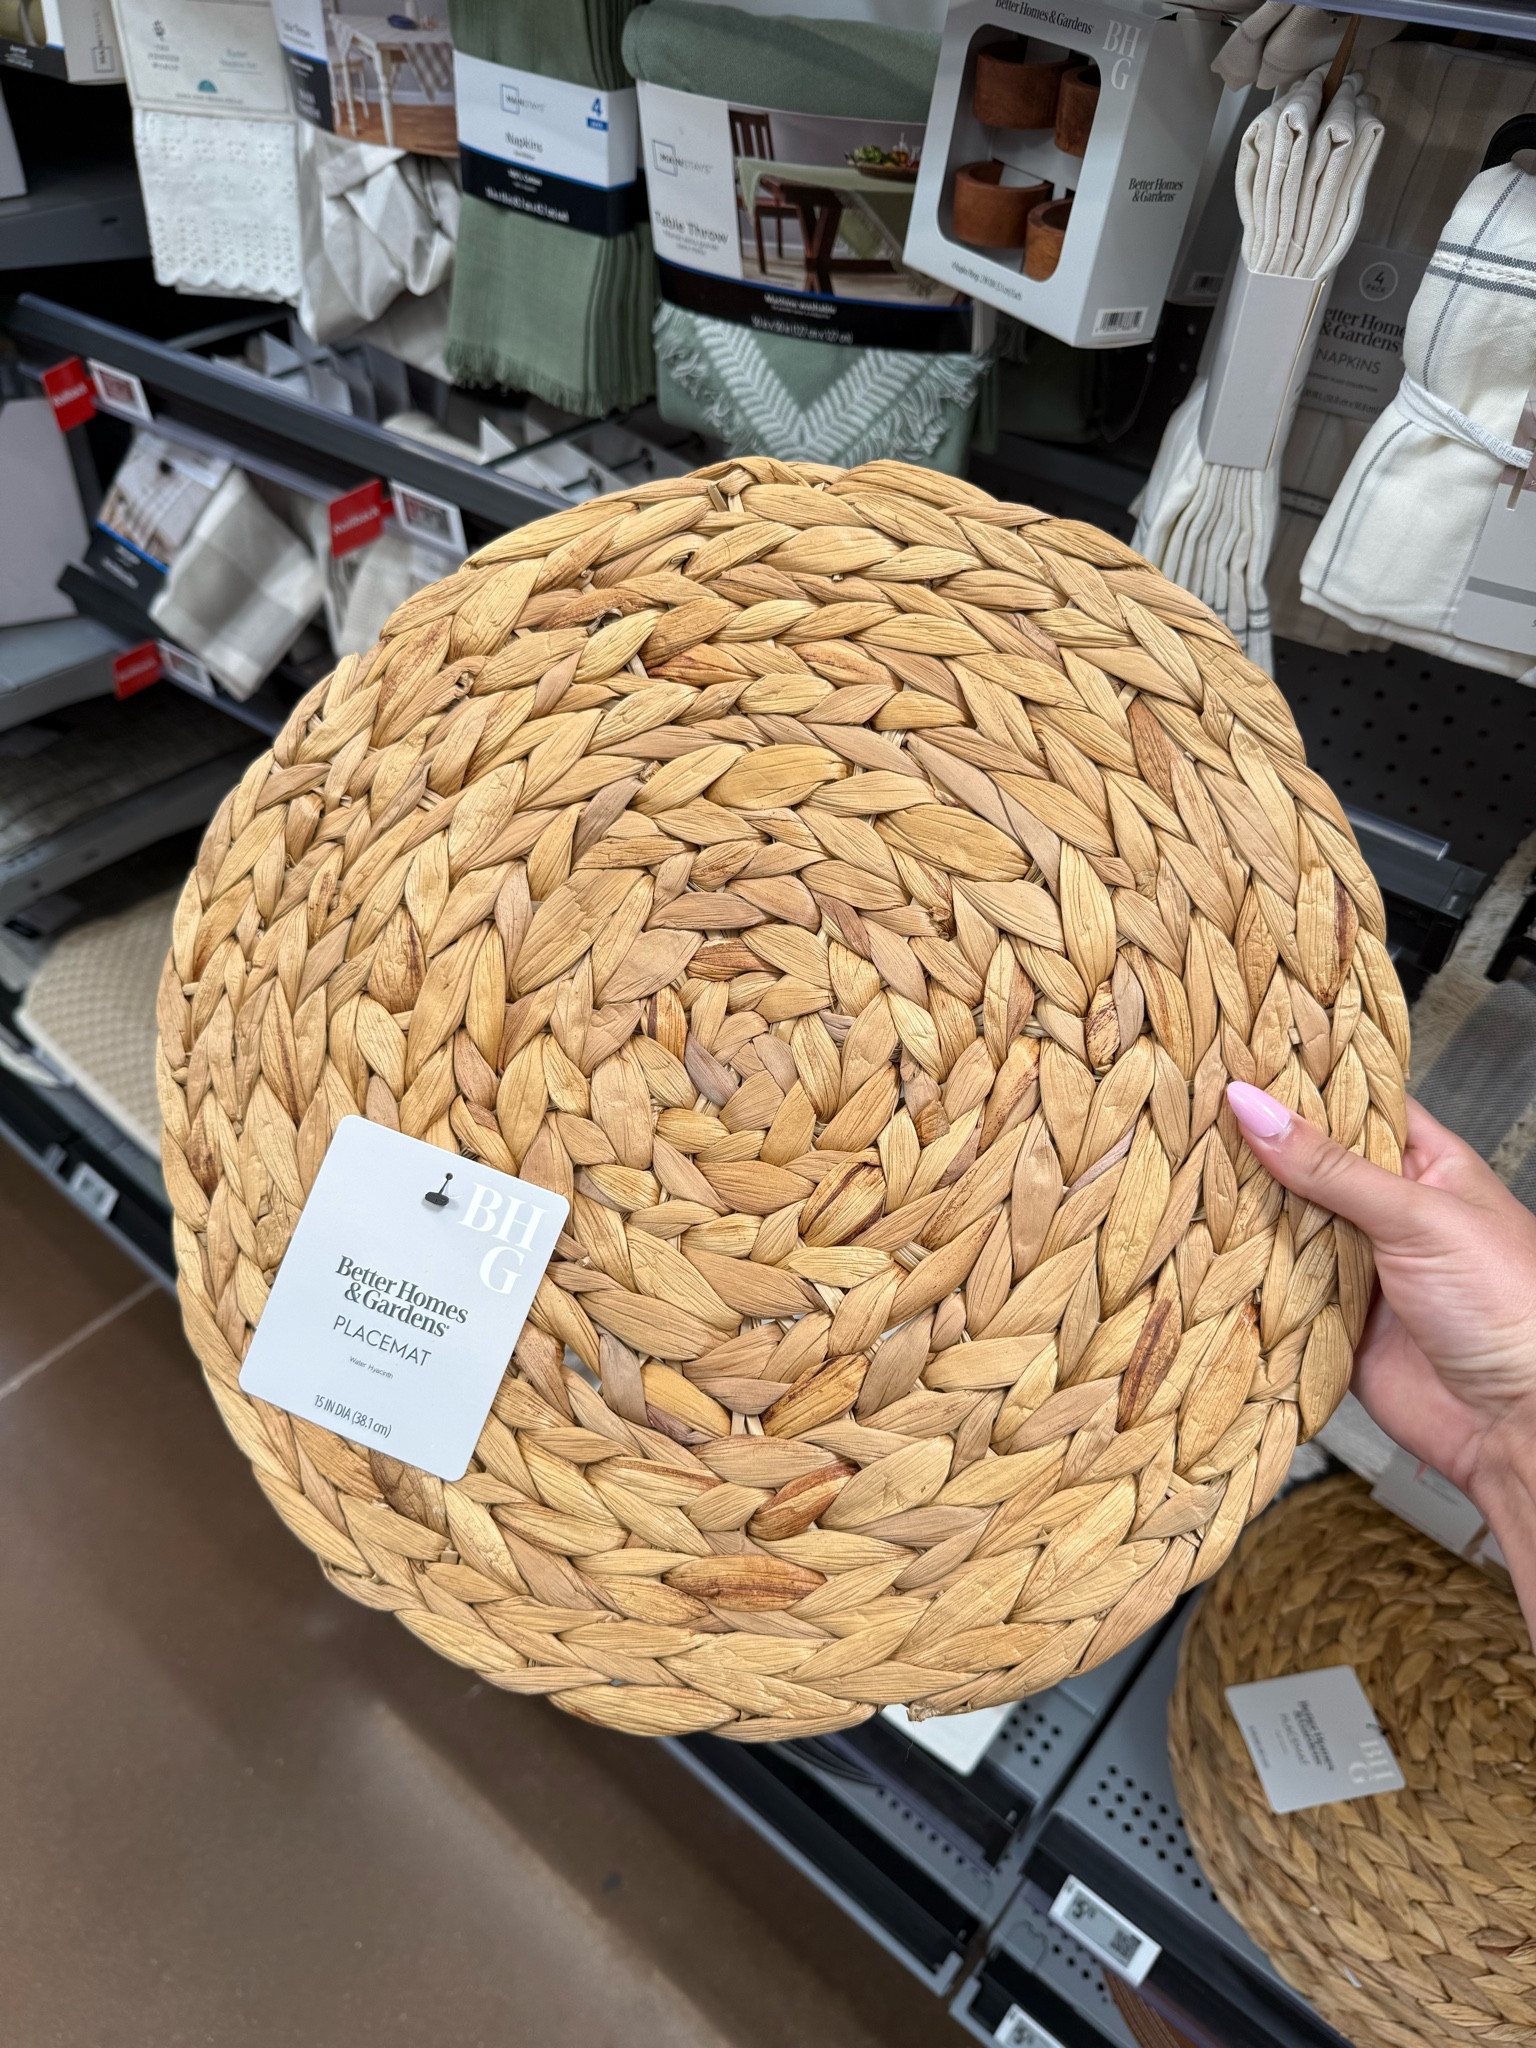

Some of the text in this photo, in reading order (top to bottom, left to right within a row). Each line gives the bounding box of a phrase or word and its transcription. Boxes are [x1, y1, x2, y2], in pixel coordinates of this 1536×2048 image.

[995, 0, 1020, 12] Better
[1019, 1, 1048, 22] Homes
[1102, 19, 1142, 59] BH
[1111, 58, 1132, 90] G
[591, 97, 602, 116] 4
[505, 132, 543, 153] Napkins
[1128, 178, 1183, 190] Better Homes
[654, 211, 686, 233] Table
[686, 222, 728, 244] Throw
[1366, 284, 1386, 293] PACK
[1374, 271, 1385, 286] 4
[1325, 308, 1406, 337] etter Home
[1315, 347, 1381, 375] NAPKINS
[458, 1183, 548, 1252] BH
[479, 1246, 526, 1295] G
[336, 1255, 468, 1323] Better Homes
[333, 1314, 432, 1367] PLACEMAT
[350, 1356, 394, 1379] Water Hyacinth
[315, 1394, 392, 1438] 15 IN DIA (38.1 cm)
